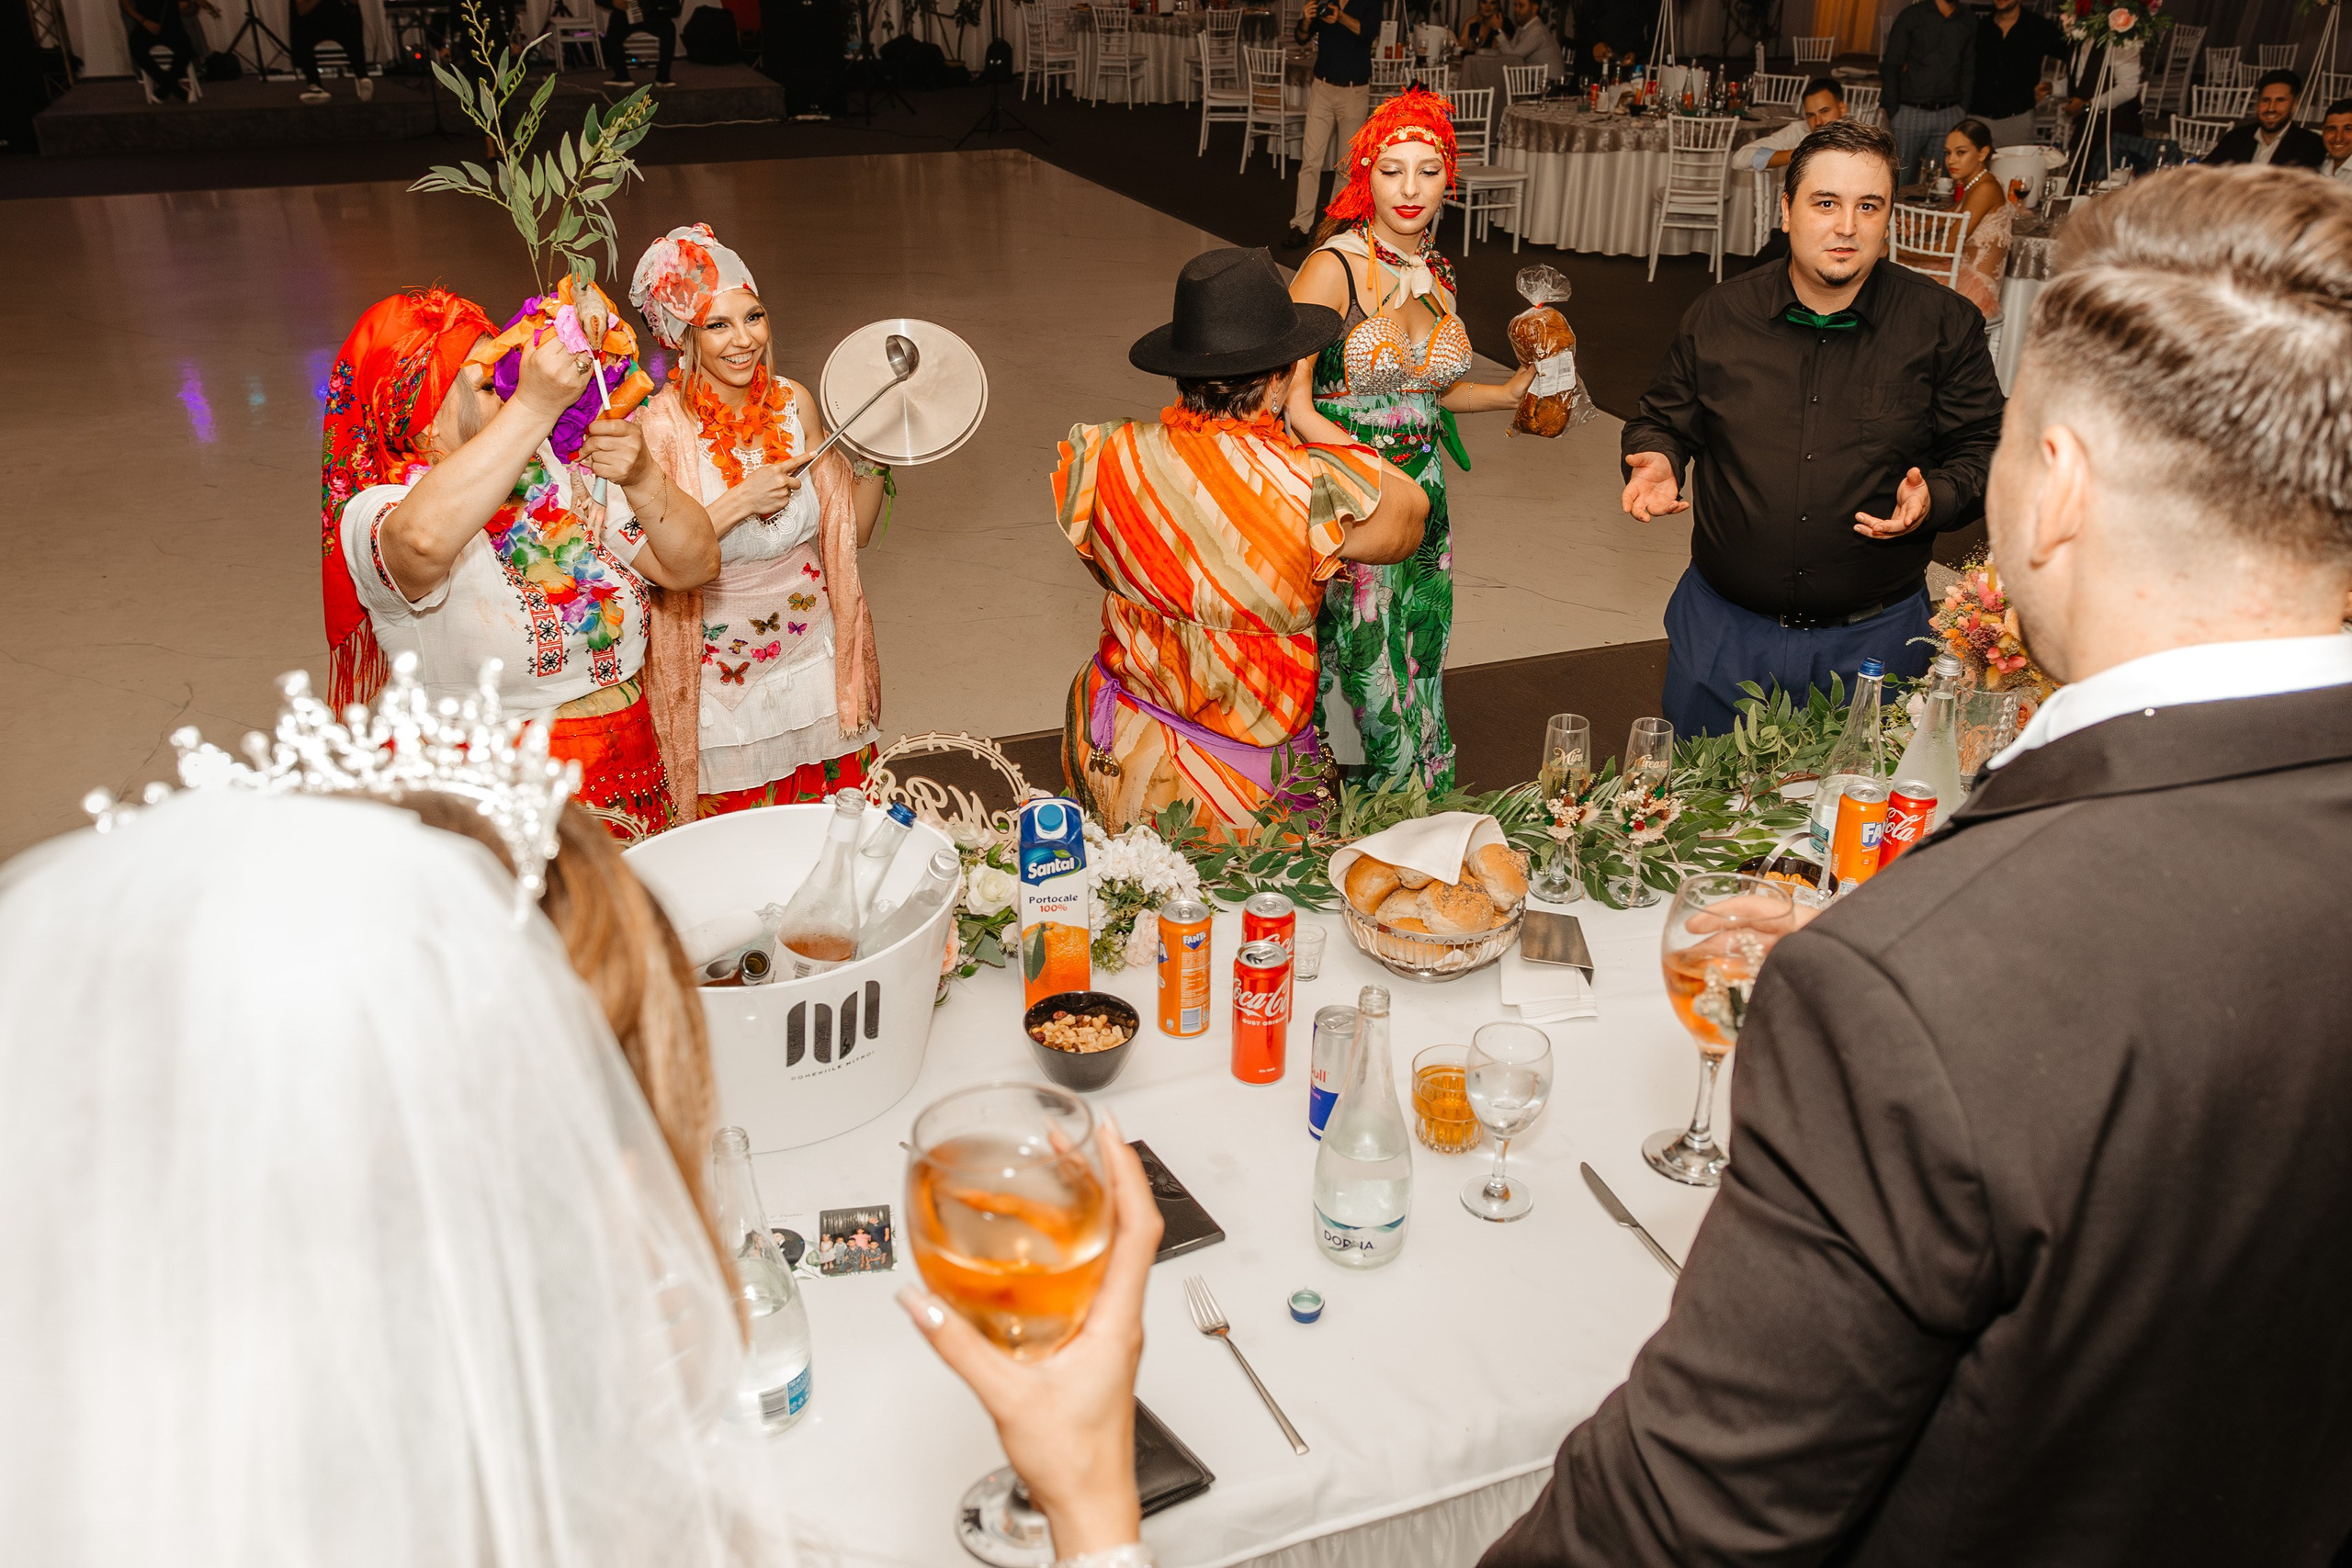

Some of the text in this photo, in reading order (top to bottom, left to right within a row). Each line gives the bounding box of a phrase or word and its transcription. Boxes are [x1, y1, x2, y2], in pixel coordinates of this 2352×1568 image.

[1028, 857, 1075, 879] Santal
[1029, 894, 1079, 904] Portocale
[1040, 904, 1068, 912] 100%
[791, 1065, 842, 1080] DOMENIILE
[1312, 1066, 1327, 1083] ull
